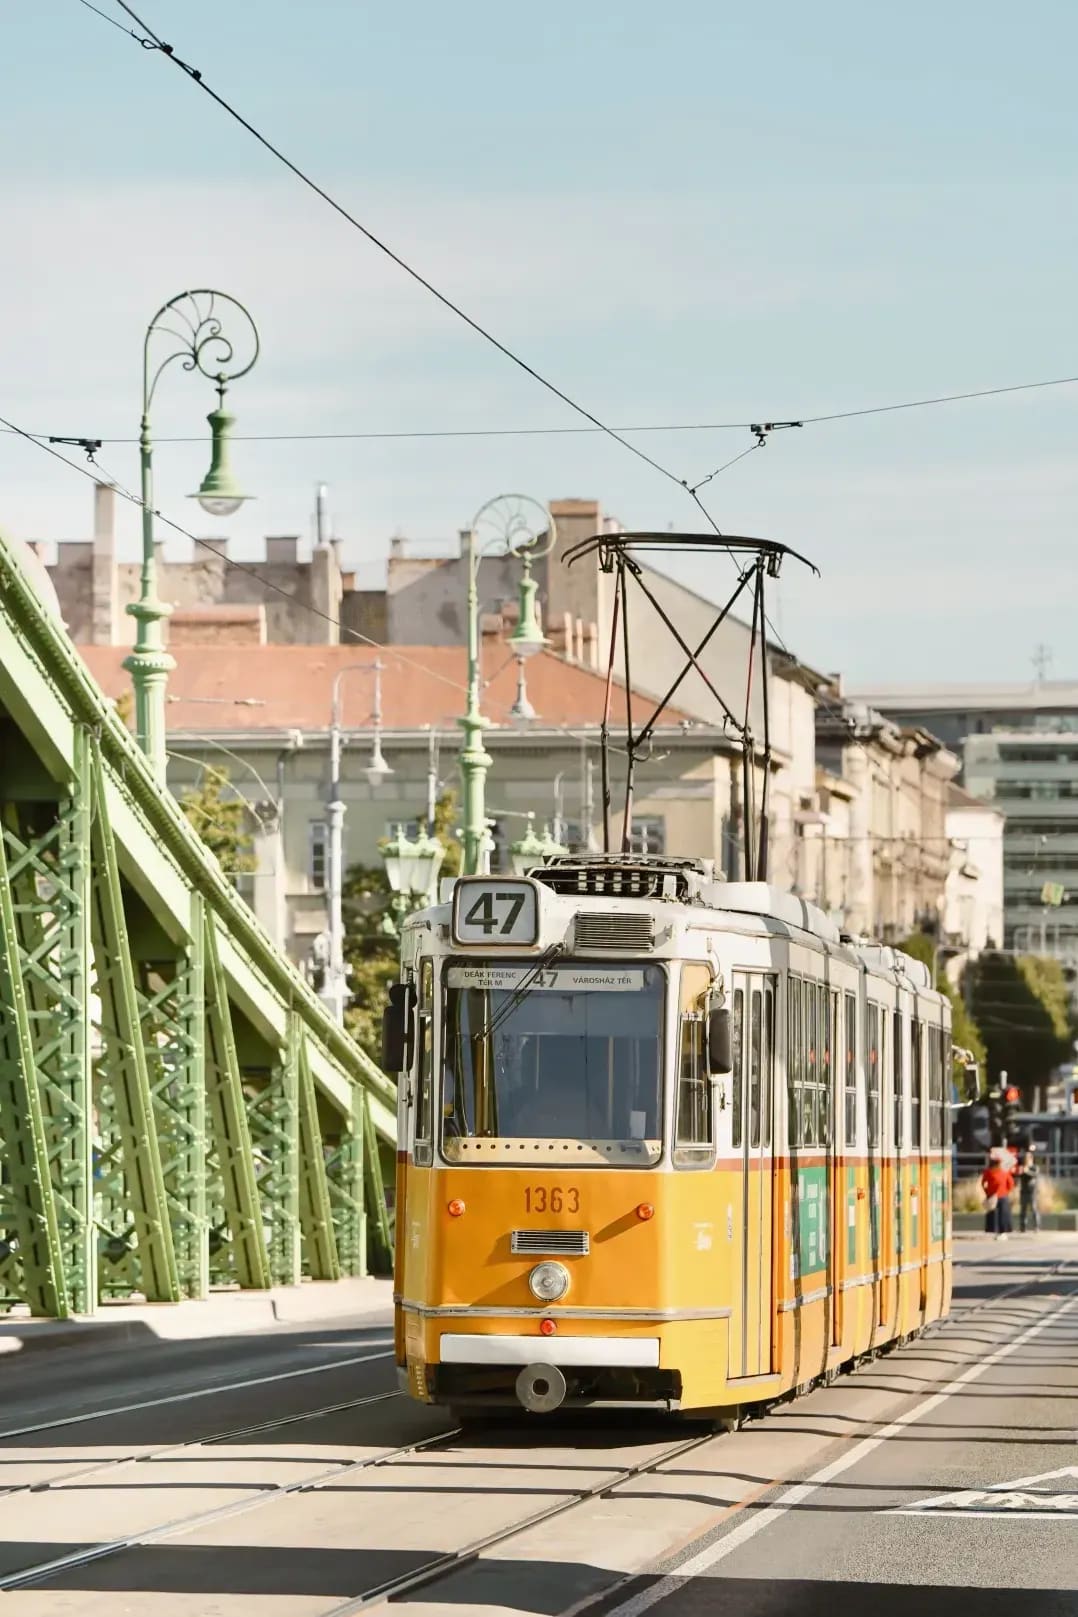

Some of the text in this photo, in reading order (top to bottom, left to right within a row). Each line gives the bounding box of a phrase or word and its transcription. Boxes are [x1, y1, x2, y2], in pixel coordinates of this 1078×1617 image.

[464, 892, 526, 935] 47
[487, 971, 517, 979] FERENC
[532, 971, 558, 988] 47
[524, 1186, 580, 1214] 1363
